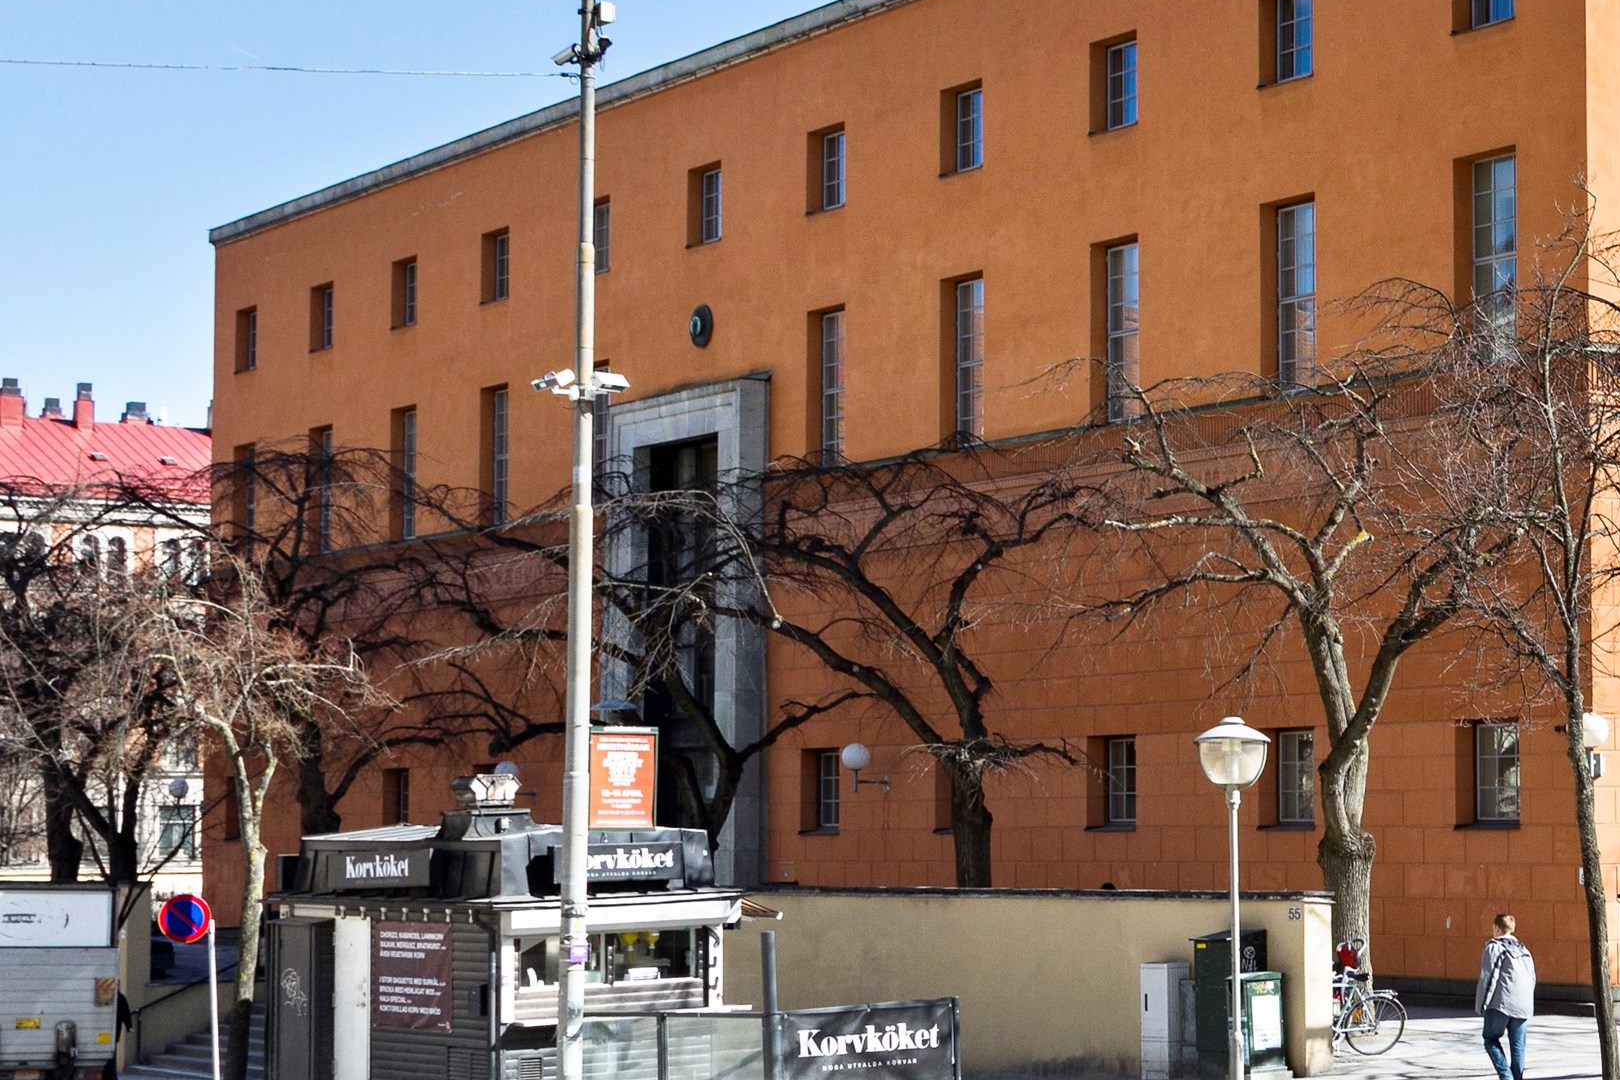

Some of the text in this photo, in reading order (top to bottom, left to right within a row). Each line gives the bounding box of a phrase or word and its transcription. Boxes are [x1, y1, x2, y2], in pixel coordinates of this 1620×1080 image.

[345, 854, 409, 878] Korvköket
[587, 847, 674, 870] orvköket
[1289, 908, 1301, 920] 55
[798, 1022, 940, 1058] Korvköket
[887, 1058, 917, 1066] KORVAR
